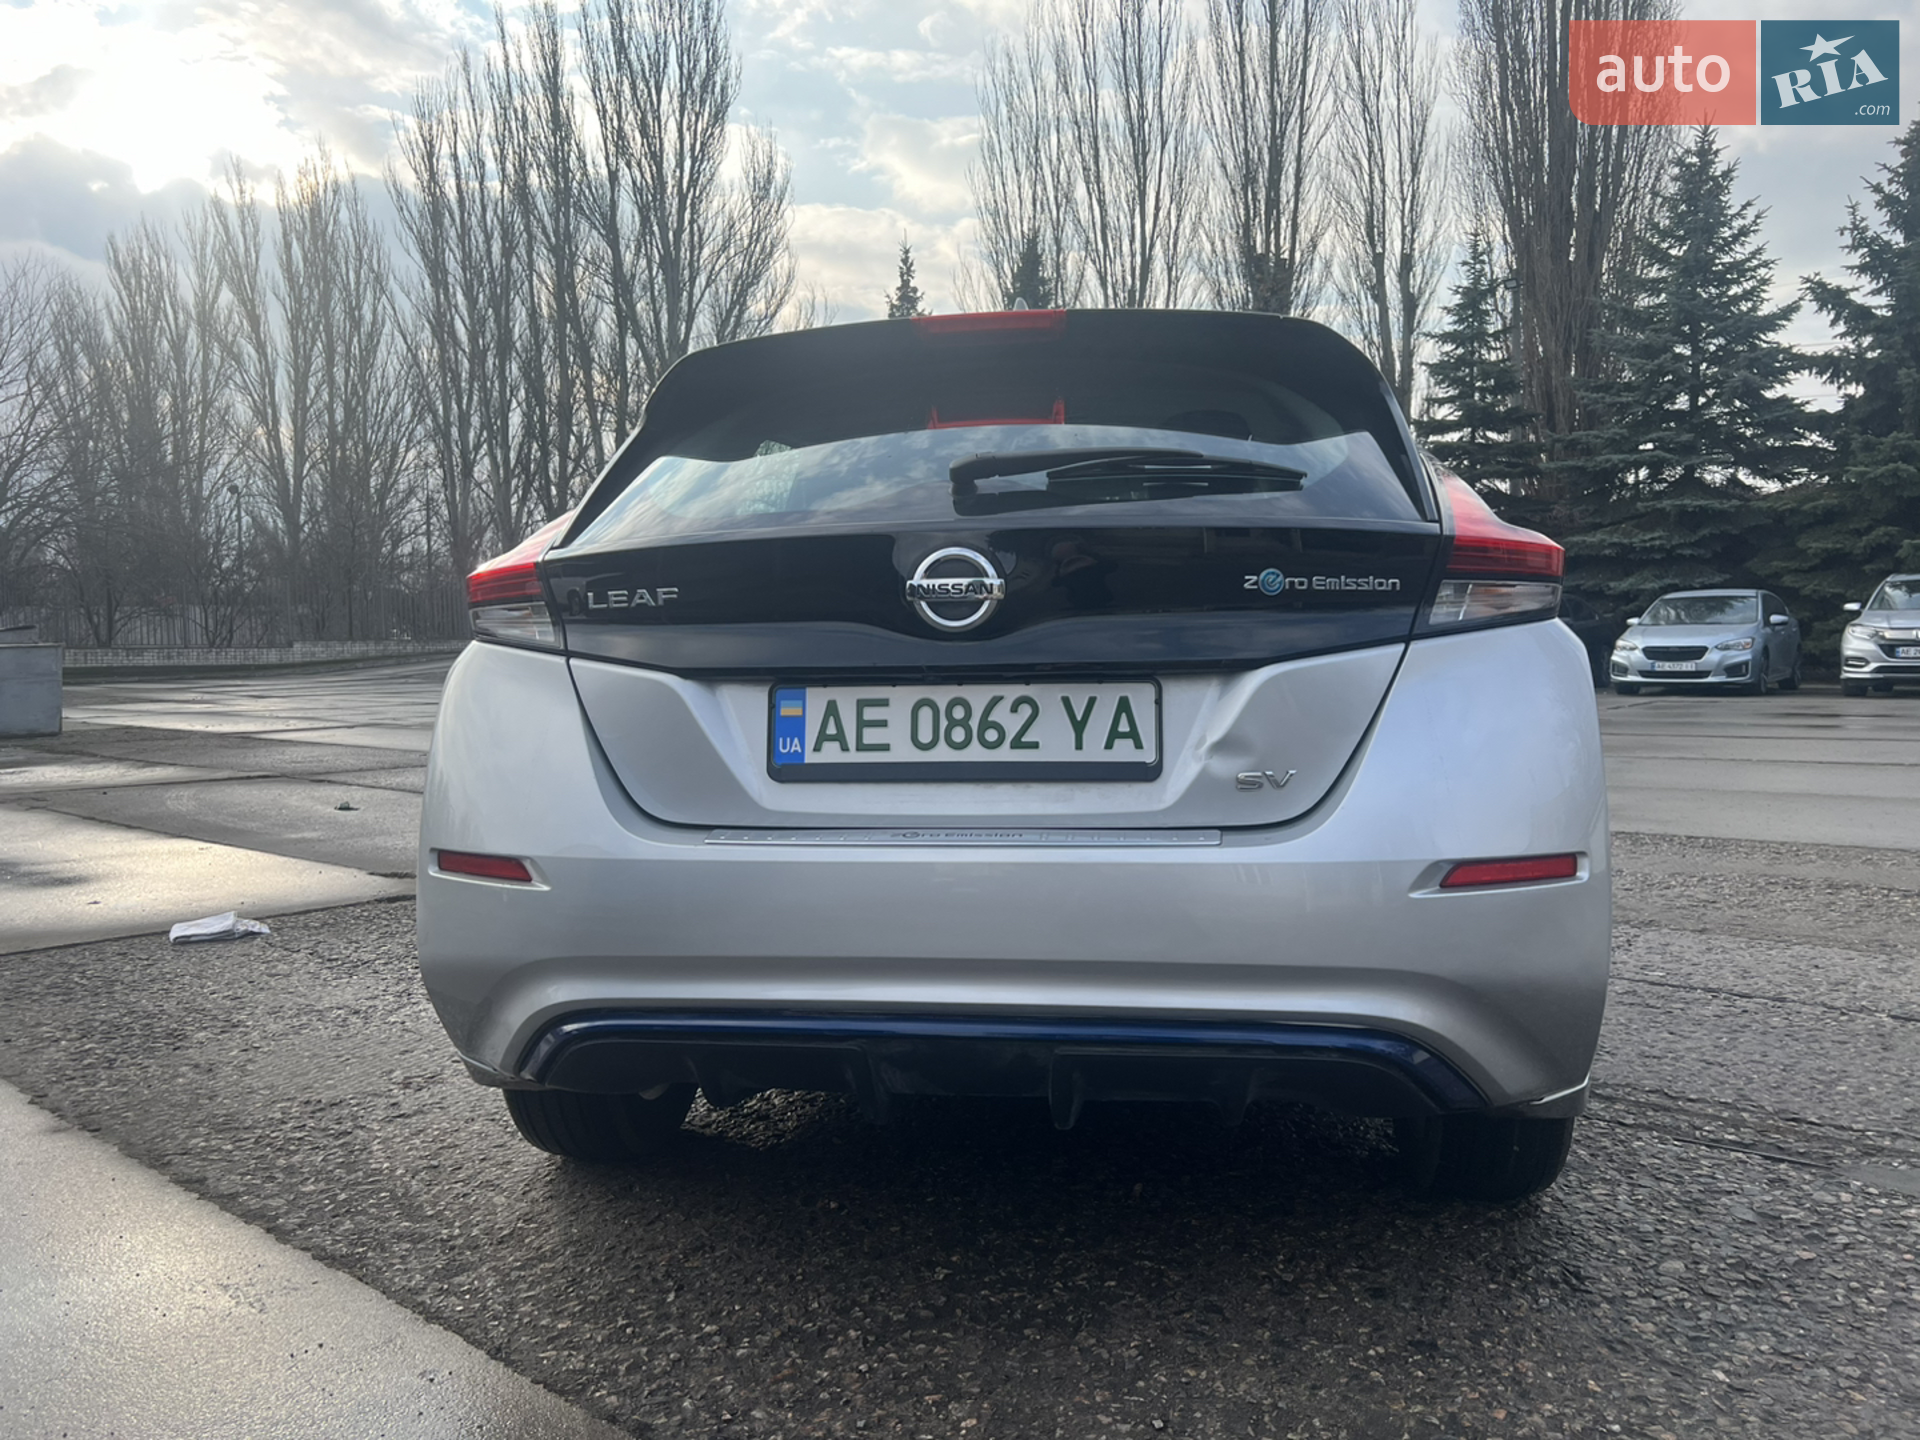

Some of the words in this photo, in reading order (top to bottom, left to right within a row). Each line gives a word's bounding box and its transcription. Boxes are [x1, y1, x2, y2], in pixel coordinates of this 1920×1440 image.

[916, 583, 994, 596] NISSAN
[1312, 575, 1401, 591] Emission
[587, 587, 679, 610] LEAF
[813, 698, 891, 752] AE
[910, 695, 1040, 751] 0862
[1060, 695, 1144, 750] YA
[779, 737, 802, 753] UA
[1236, 770, 1297, 792] SV
